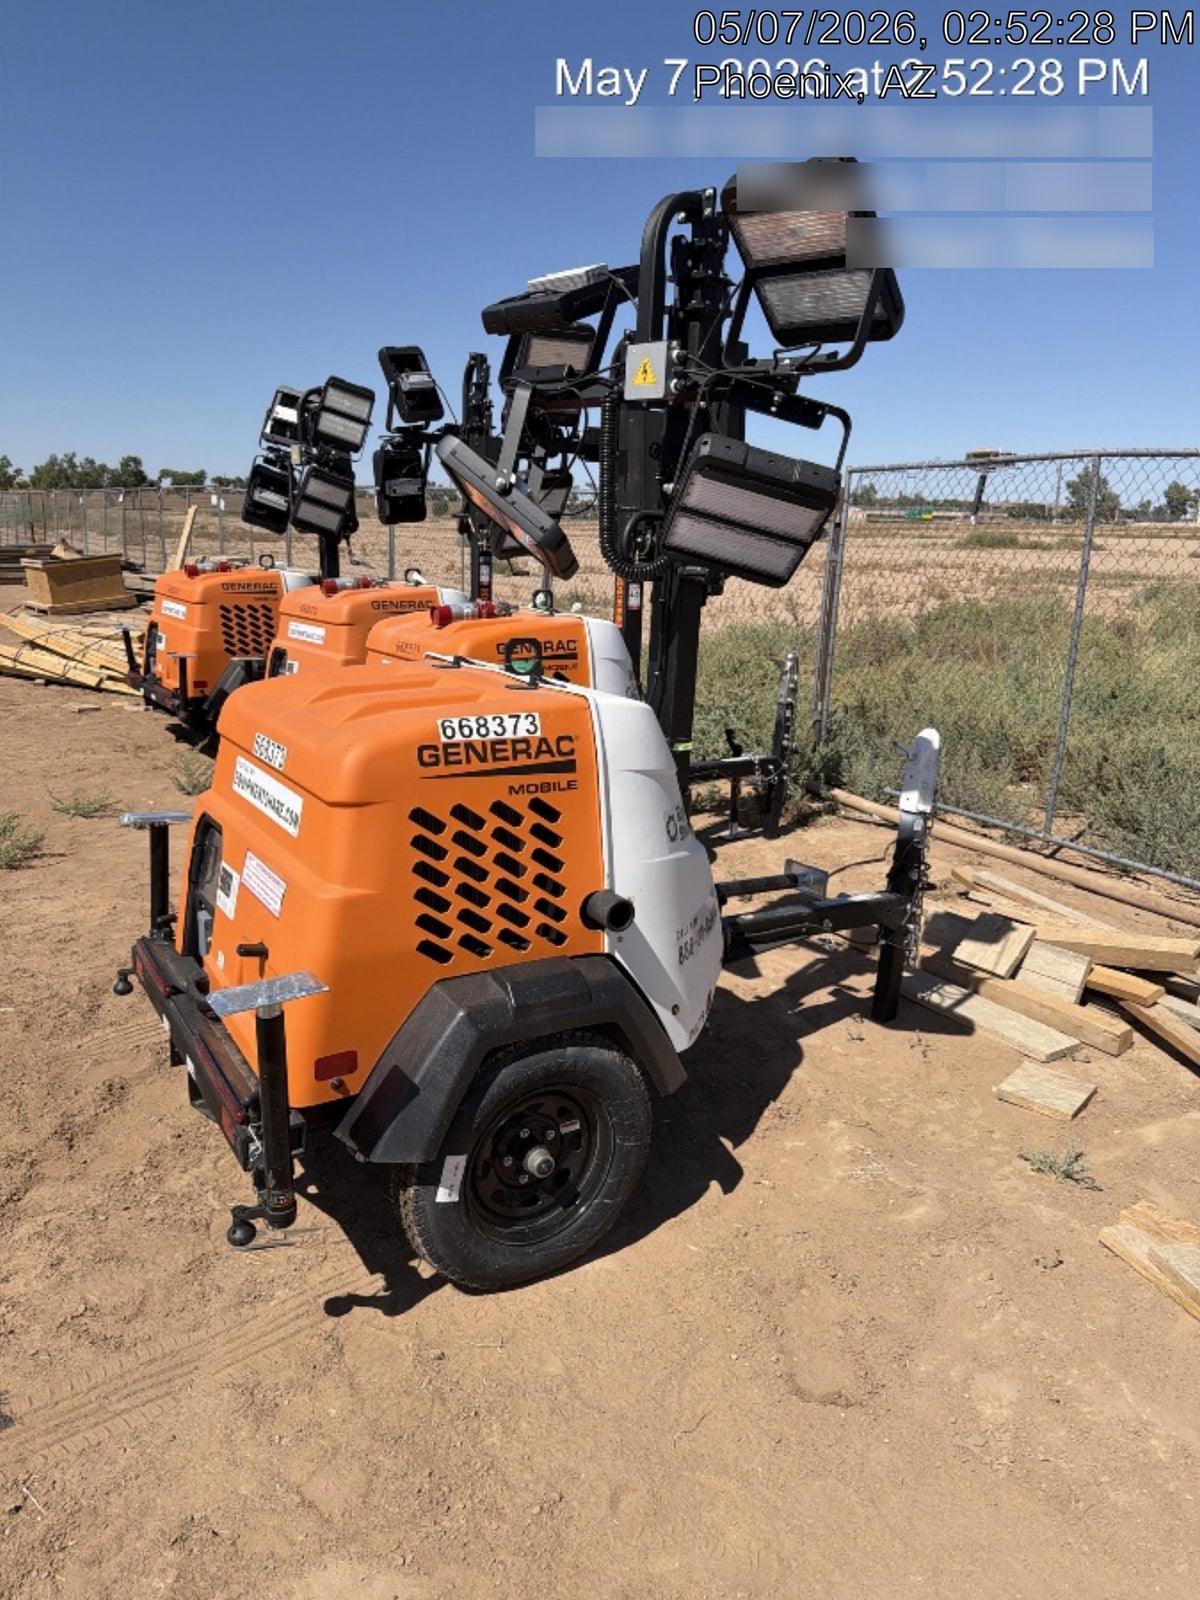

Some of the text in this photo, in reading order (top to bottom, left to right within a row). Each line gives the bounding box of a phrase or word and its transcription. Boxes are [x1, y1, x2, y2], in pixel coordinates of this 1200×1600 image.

[371, 600, 434, 611] GENERAC
[496, 639, 577, 655] GENRAC
[440, 713, 539, 740] 668373
[417, 735, 576, 768] GENERAC
[508, 779, 578, 796] MOBILE
